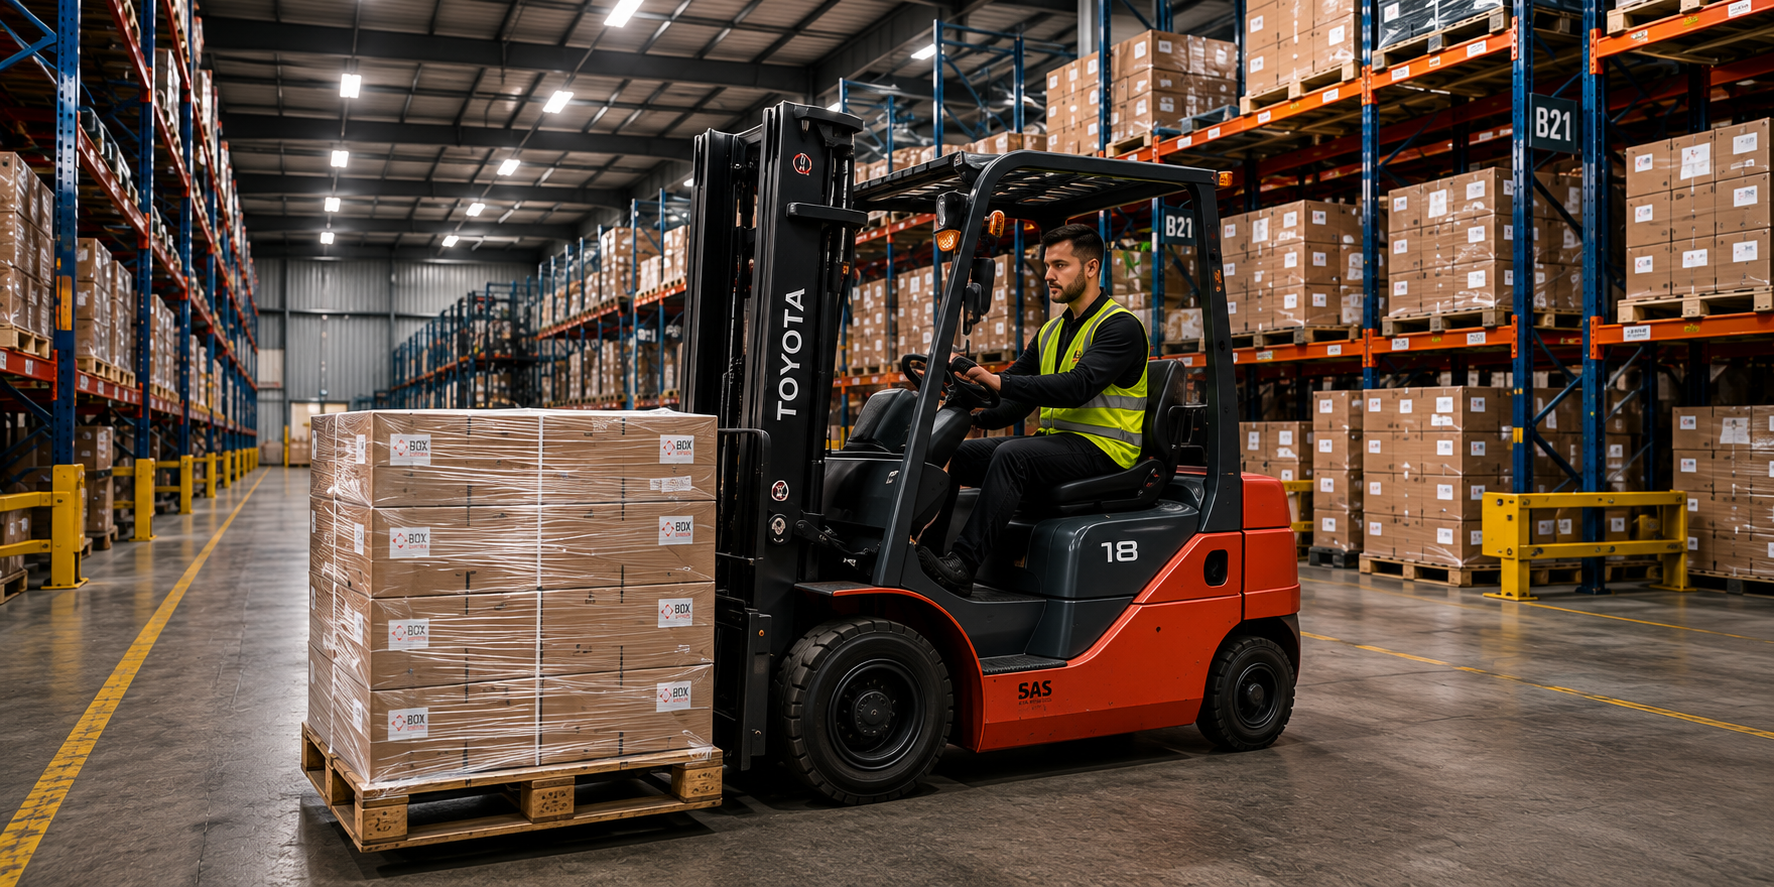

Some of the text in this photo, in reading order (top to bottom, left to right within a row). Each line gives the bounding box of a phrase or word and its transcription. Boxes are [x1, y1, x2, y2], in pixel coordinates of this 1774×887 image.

[1535, 105, 1572, 142] B21
[1165, 215, 1193, 239] B21
[776, 287, 806, 421] TOYOTA
[409, 440, 428, 452] BOX
[676, 440, 693, 451] BOX
[675, 521, 692, 532] BOX
[408, 533, 427, 544] BOX
[1100, 540, 1139, 563] 18
[674, 603, 691, 614] BOX
[407, 625, 426, 636] BOX
[672, 687, 690, 698] BOX
[1018, 680, 1053, 700] SAS
[407, 714, 425, 725] BOX
